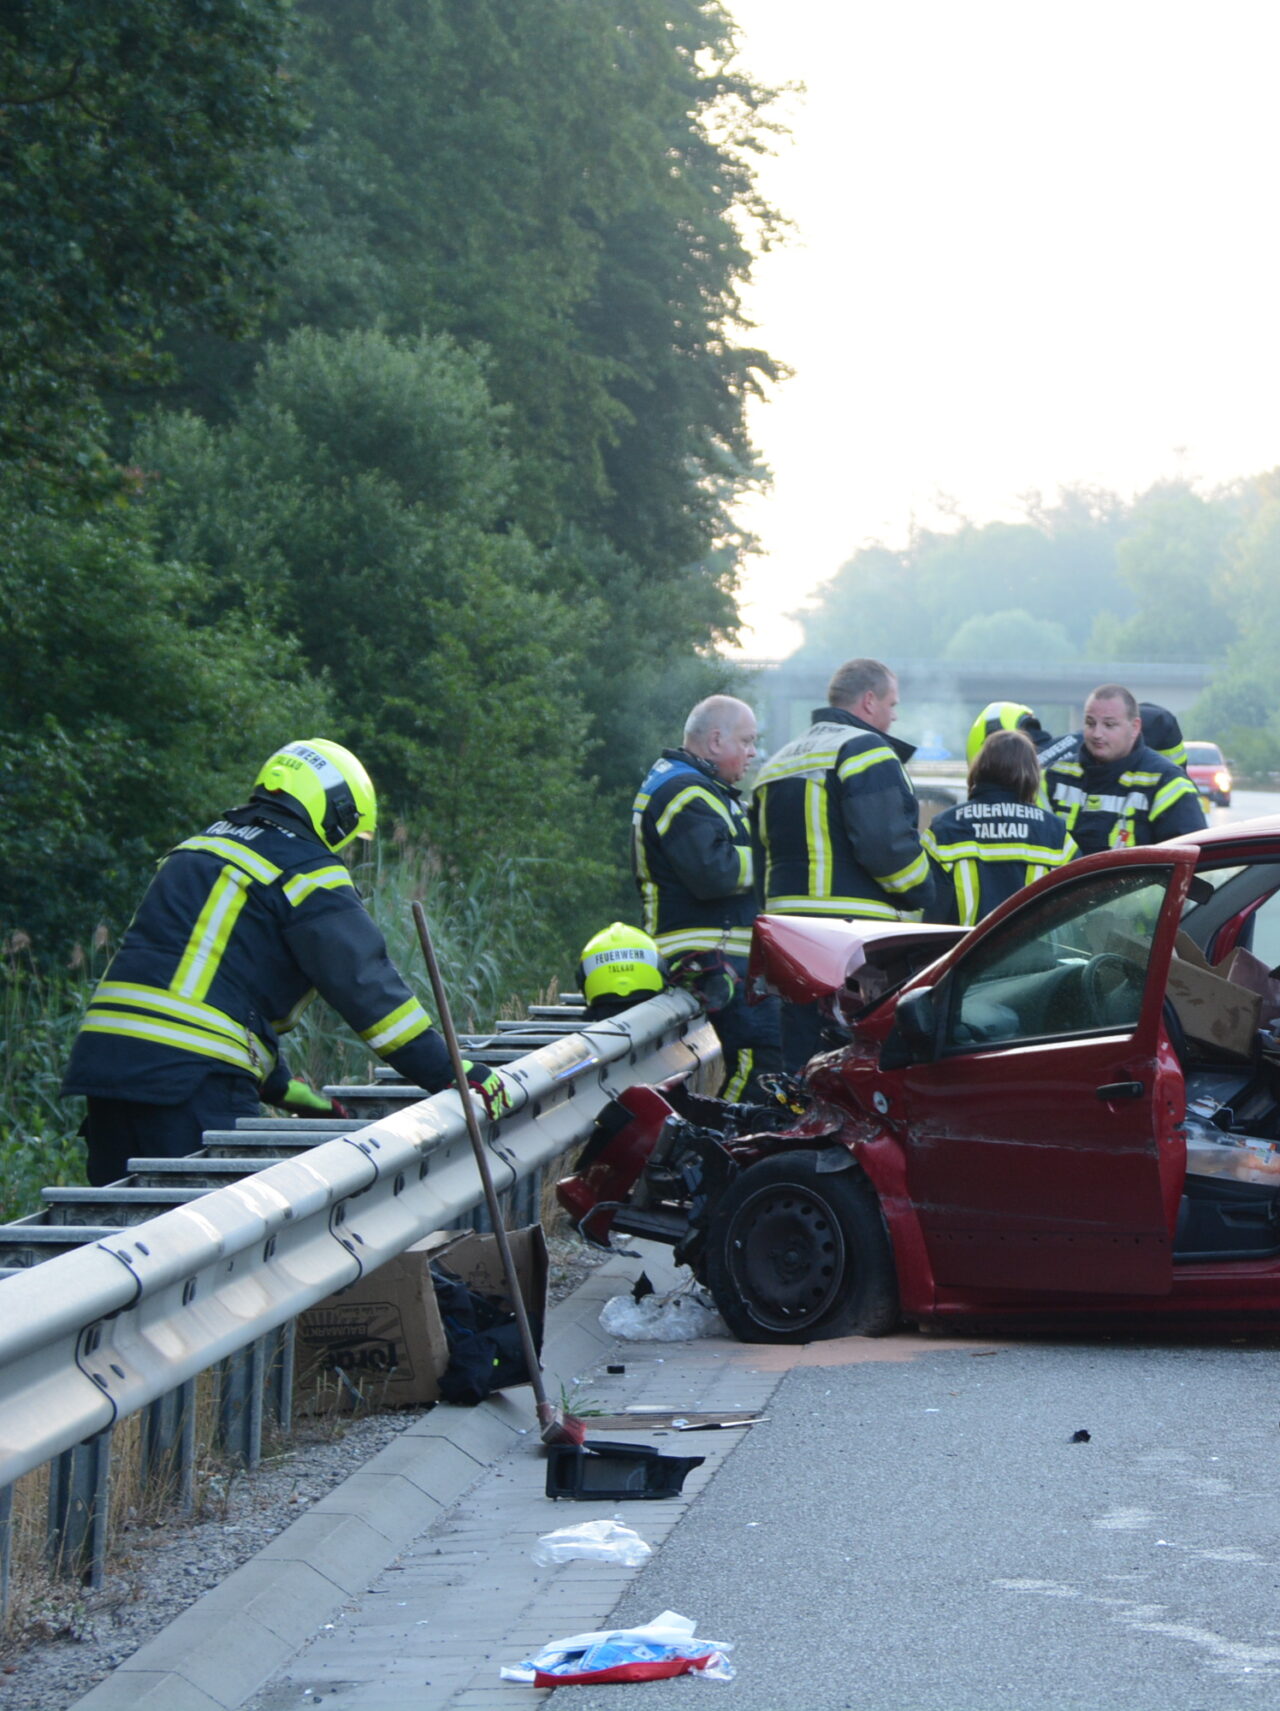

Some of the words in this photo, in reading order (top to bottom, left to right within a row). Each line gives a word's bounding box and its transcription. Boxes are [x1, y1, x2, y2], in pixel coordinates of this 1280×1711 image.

[955, 802, 1045, 822] FEUERWEHR
[971, 822, 1029, 839] TALKAU
[595, 948, 645, 965] FEUERWEHR
